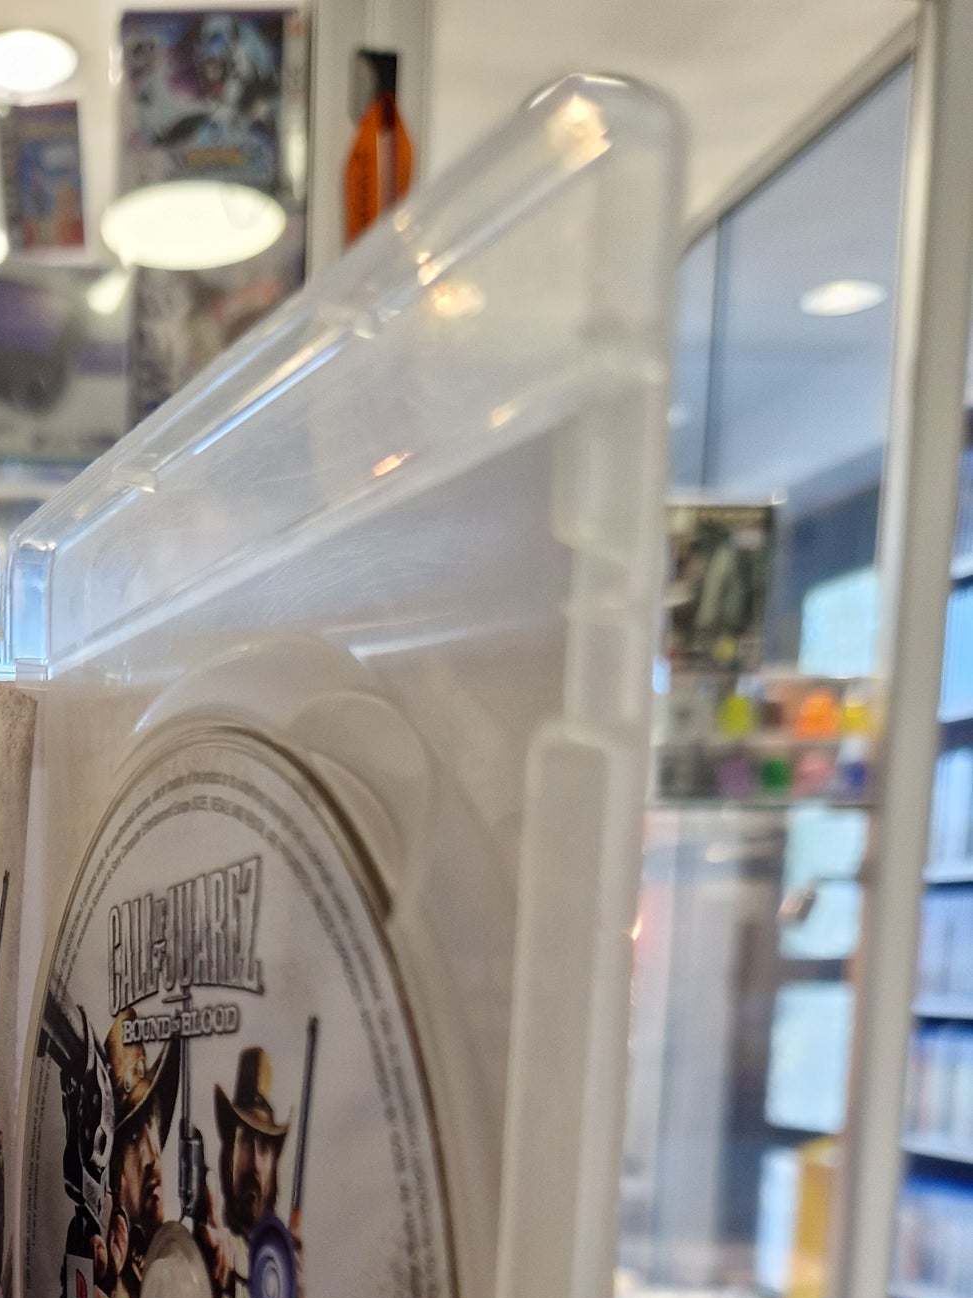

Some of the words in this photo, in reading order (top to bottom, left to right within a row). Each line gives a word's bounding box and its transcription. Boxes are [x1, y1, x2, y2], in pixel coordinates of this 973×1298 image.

[108, 893, 159, 1017] CALL
[161, 855, 264, 996] JUAREZ
[122, 1016, 171, 1045] BOUND
[180, 1005, 240, 1037] BLOOD
